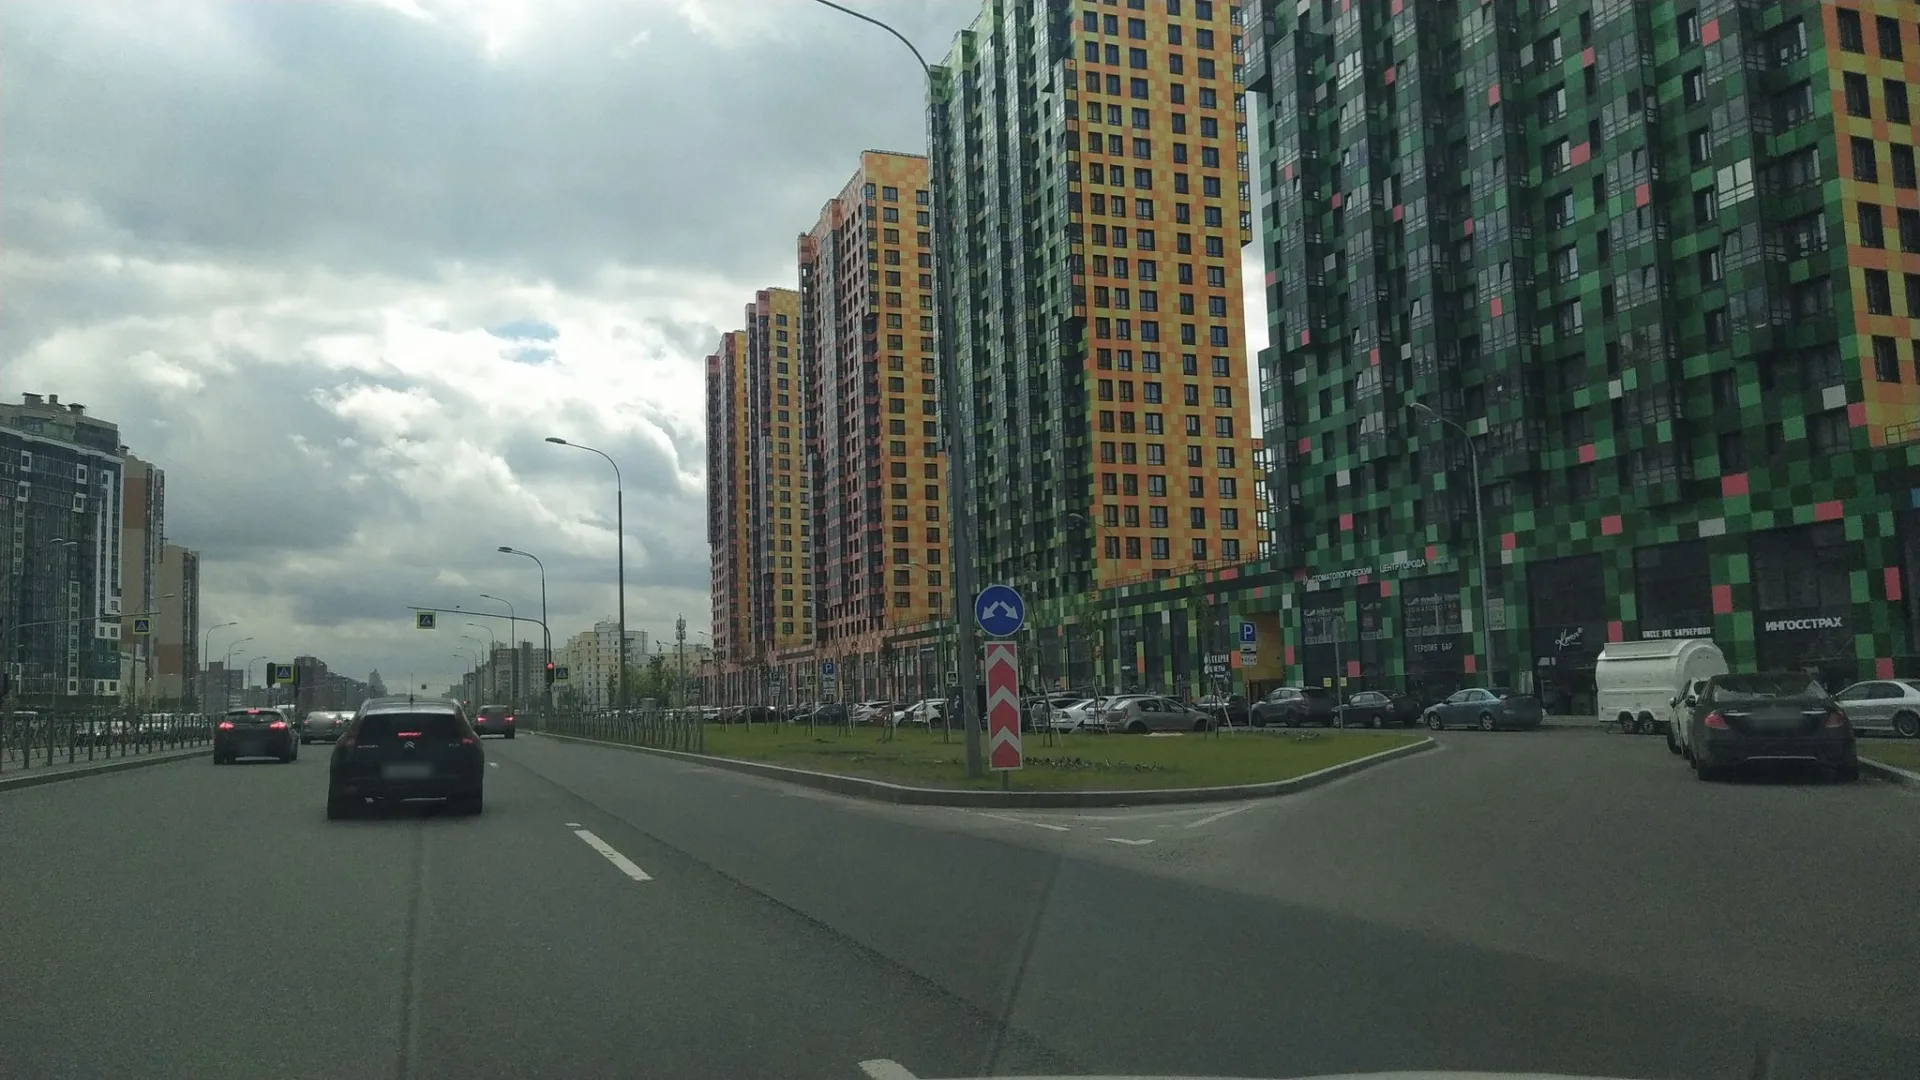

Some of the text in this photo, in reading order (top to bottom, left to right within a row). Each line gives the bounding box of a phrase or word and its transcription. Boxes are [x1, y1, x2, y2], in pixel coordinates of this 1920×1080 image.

[1312, 565, 1373, 583] СТОМАТОЛОГИЧЕСКИЙ
[1379, 562, 1399, 573] ЦЕНТР
[1399, 558, 1426, 570] ГОРОДА
[1765, 616, 1842, 632] ИНГОССТРАХ
